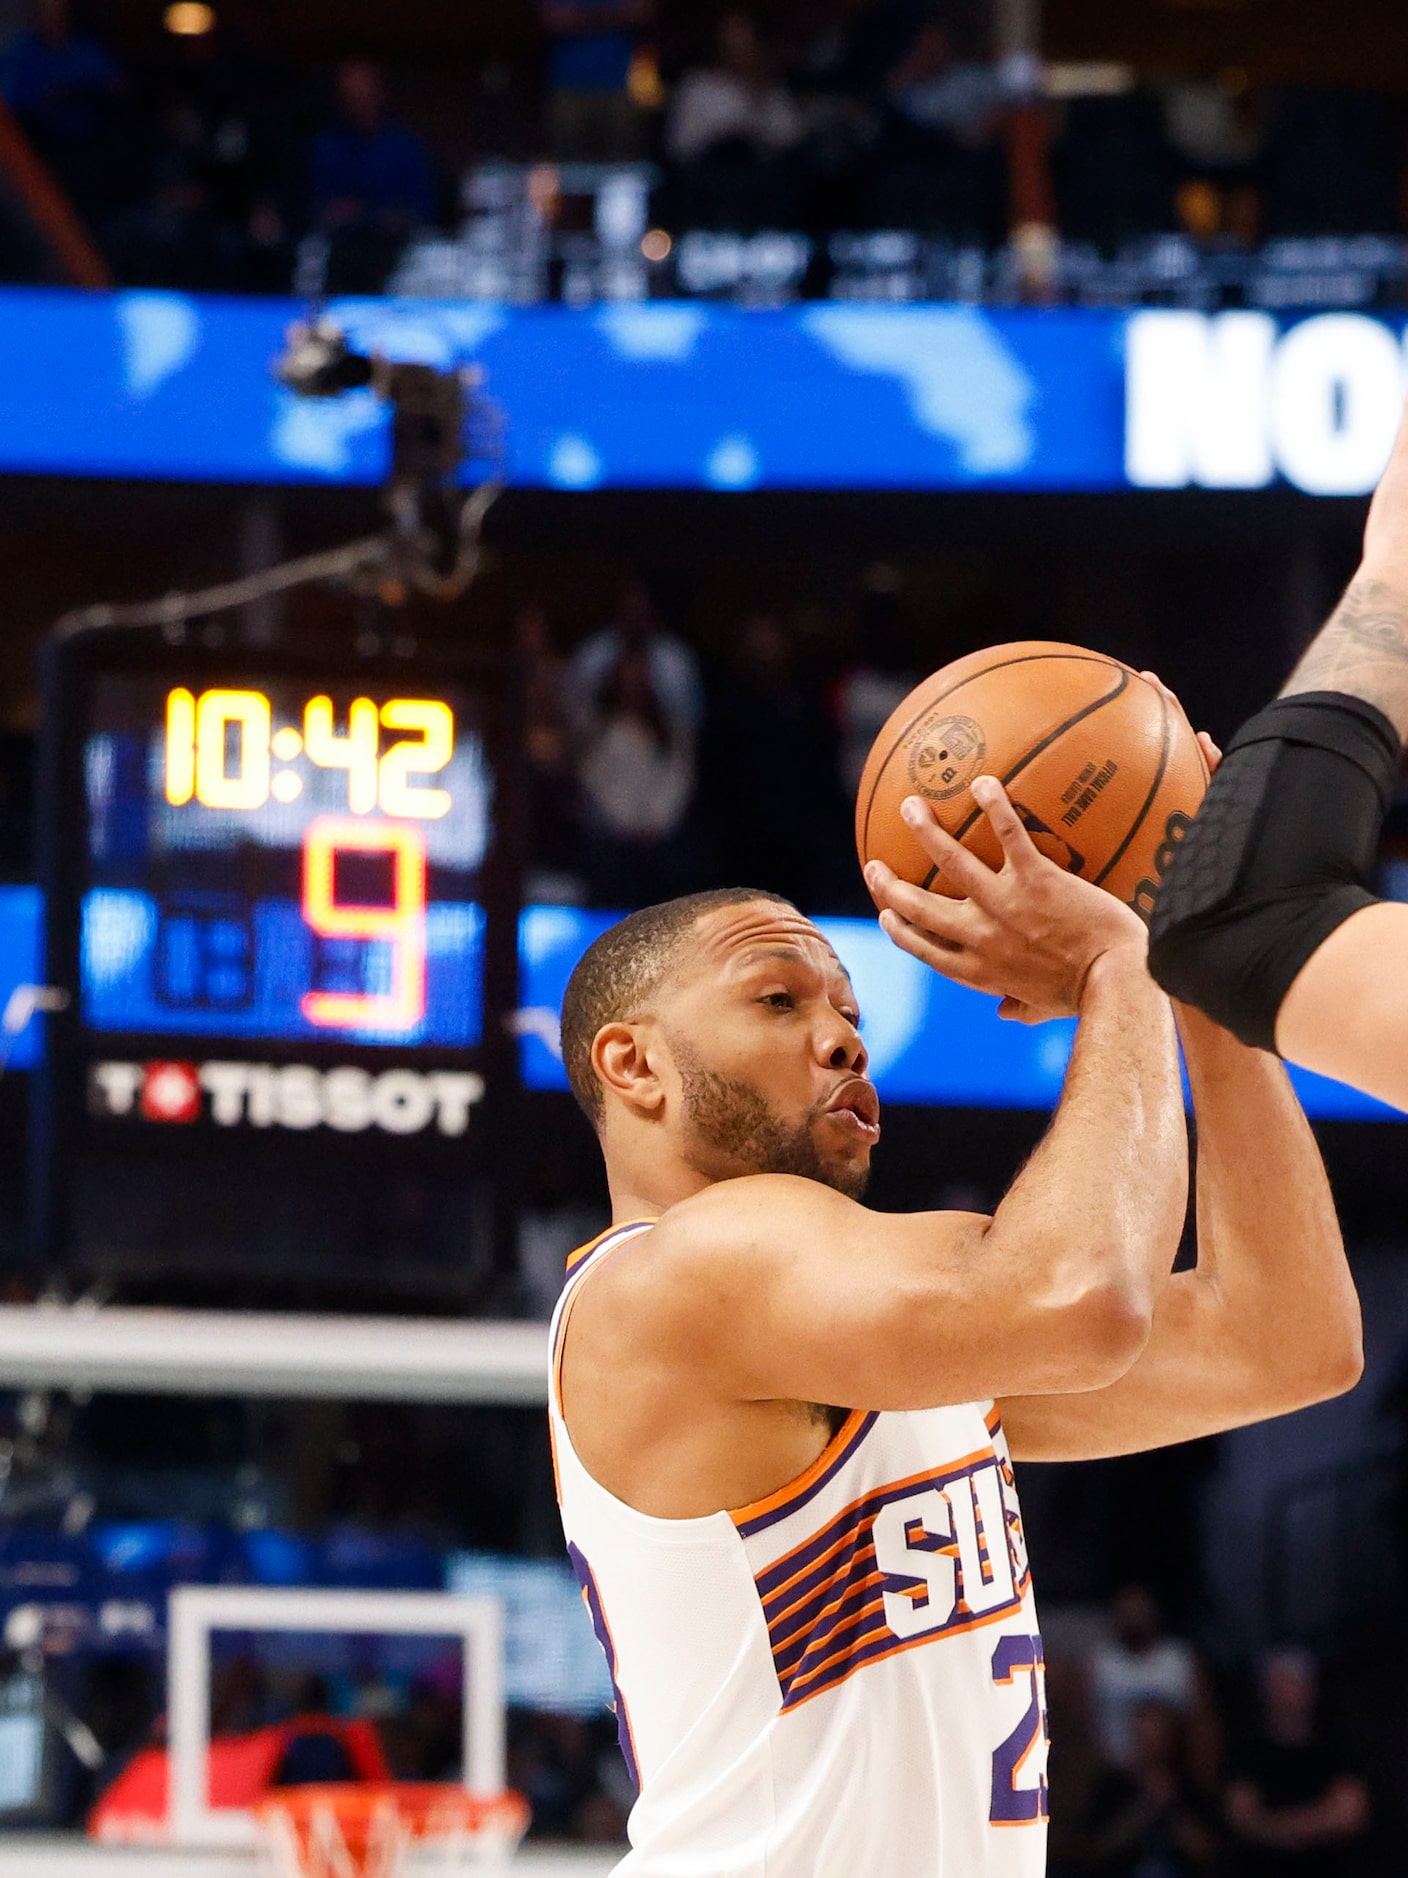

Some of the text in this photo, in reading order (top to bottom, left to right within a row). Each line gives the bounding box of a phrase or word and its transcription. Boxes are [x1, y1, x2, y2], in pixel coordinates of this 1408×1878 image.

[165, 686, 455, 819] 10:42
[302, 817, 427, 1029] 9
[200, 1060, 485, 1138] TISSOT
[989, 1634, 1050, 1827] 2
